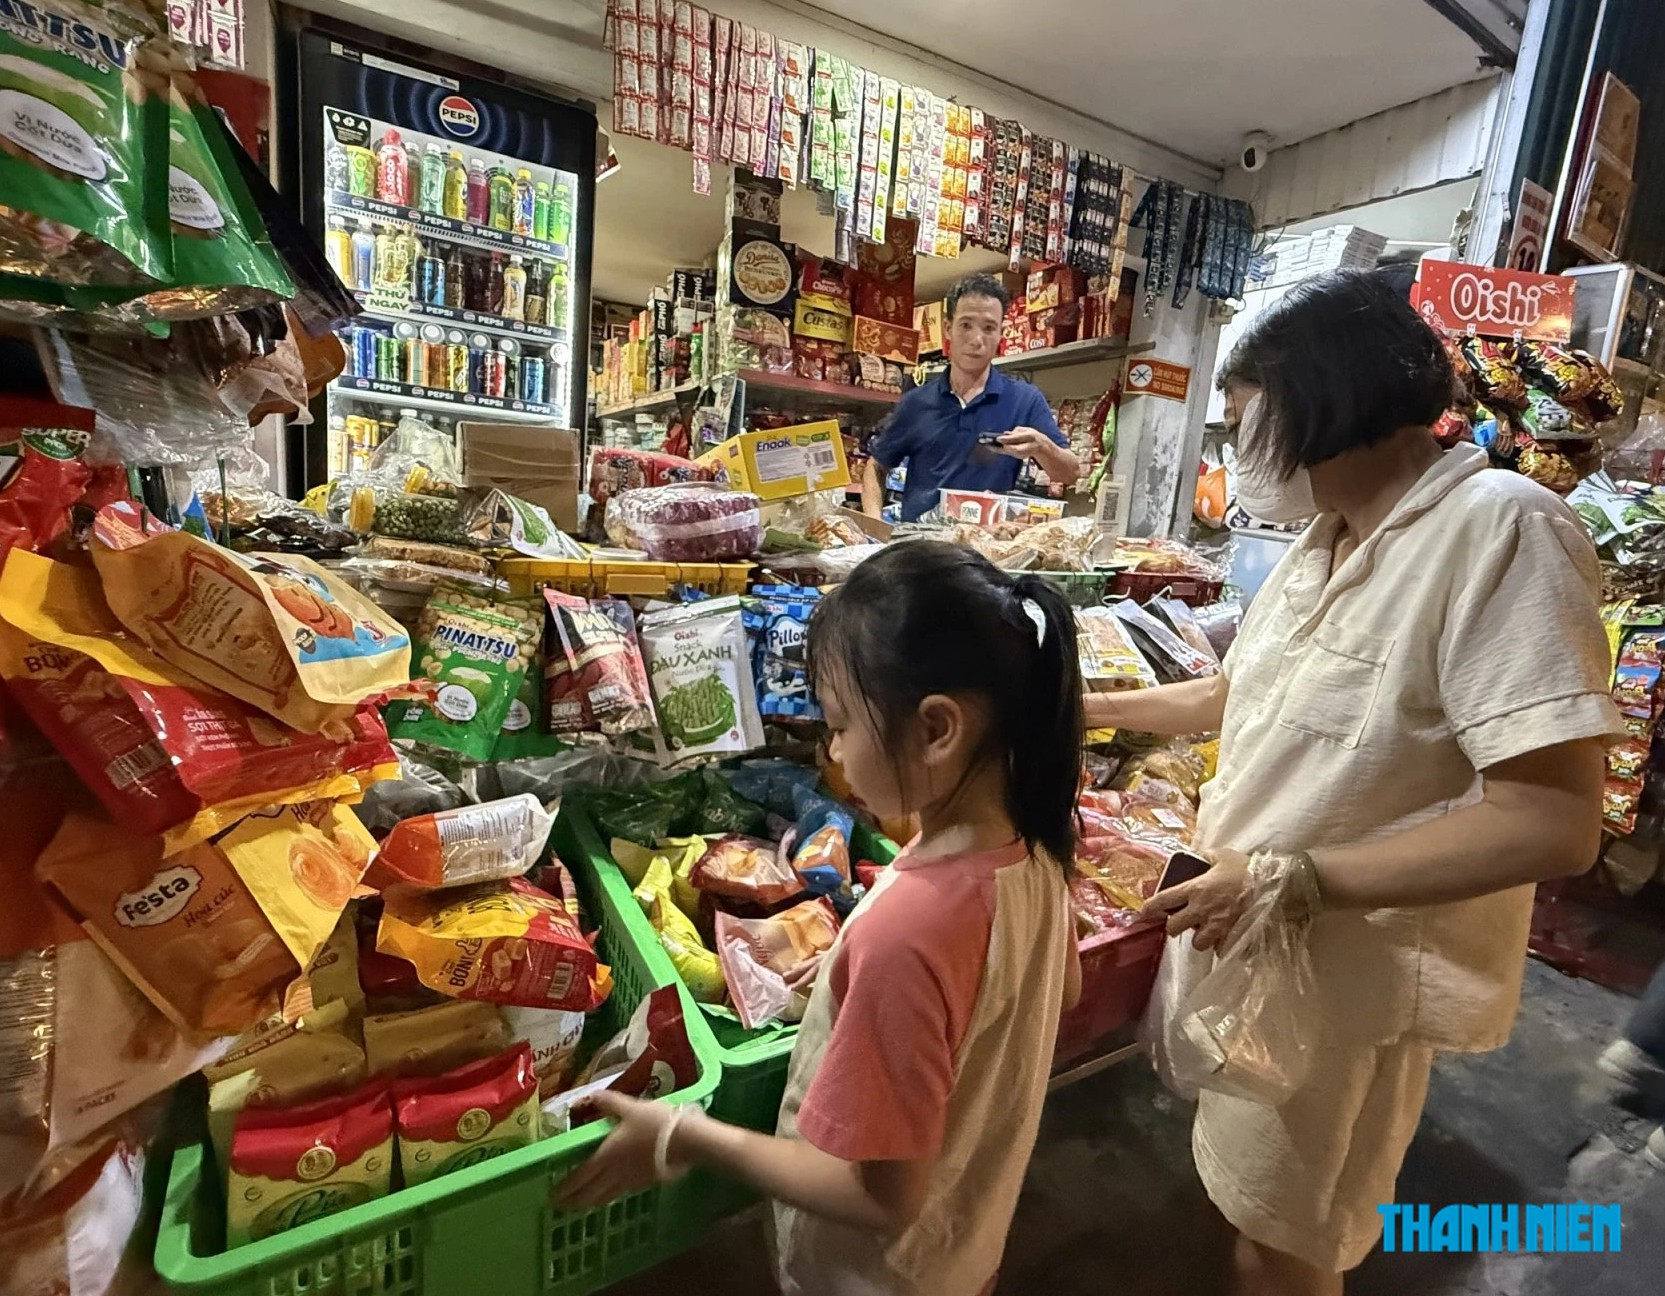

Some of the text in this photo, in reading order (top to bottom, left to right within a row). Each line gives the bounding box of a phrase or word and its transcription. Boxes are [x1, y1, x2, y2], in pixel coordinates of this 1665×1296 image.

[441, 107, 478, 125] PEPSI
[367, 201, 398, 215] PEPSI
[423, 214, 452, 229] PEPSI
[476, 227, 503, 240] PEPSI
[525, 239, 551, 252] PEPSI
[369, 298, 409, 311] NGAY
[1451, 272, 1542, 328] Oishi
[425, 306, 454, 317] PEPSI
[477, 315, 505, 327] PEPSI
[803, 312, 843, 330] Custas
[525, 323, 552, 336] PEPSI
[372, 381, 402, 393] PEPSI
[426, 390, 455, 401] PEPSI
[477, 396, 504, 408] PEPSI
[525, 403, 551, 414] PEPSI
[674, 640, 703, 653] Snack
[683, 645, 733, 668] XANH
[122, 876, 190, 921] Festa
